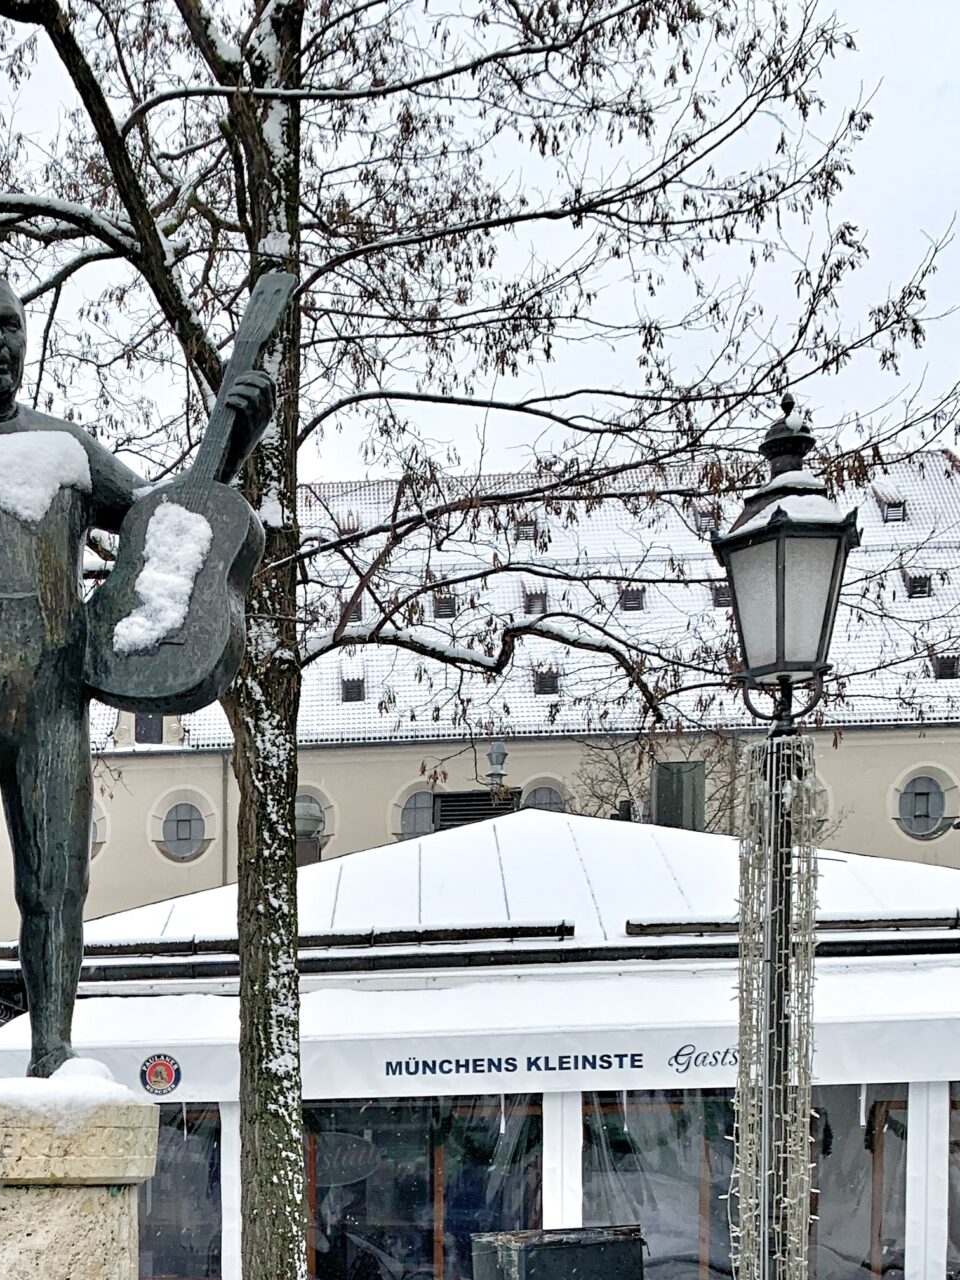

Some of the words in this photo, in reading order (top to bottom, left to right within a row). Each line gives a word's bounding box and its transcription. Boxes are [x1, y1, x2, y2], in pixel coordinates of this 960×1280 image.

[384, 1056, 519, 1077] MÜNCHENS
[526, 1052, 644, 1072] KLEINSTE
[667, 1043, 740, 1074] Gasts
